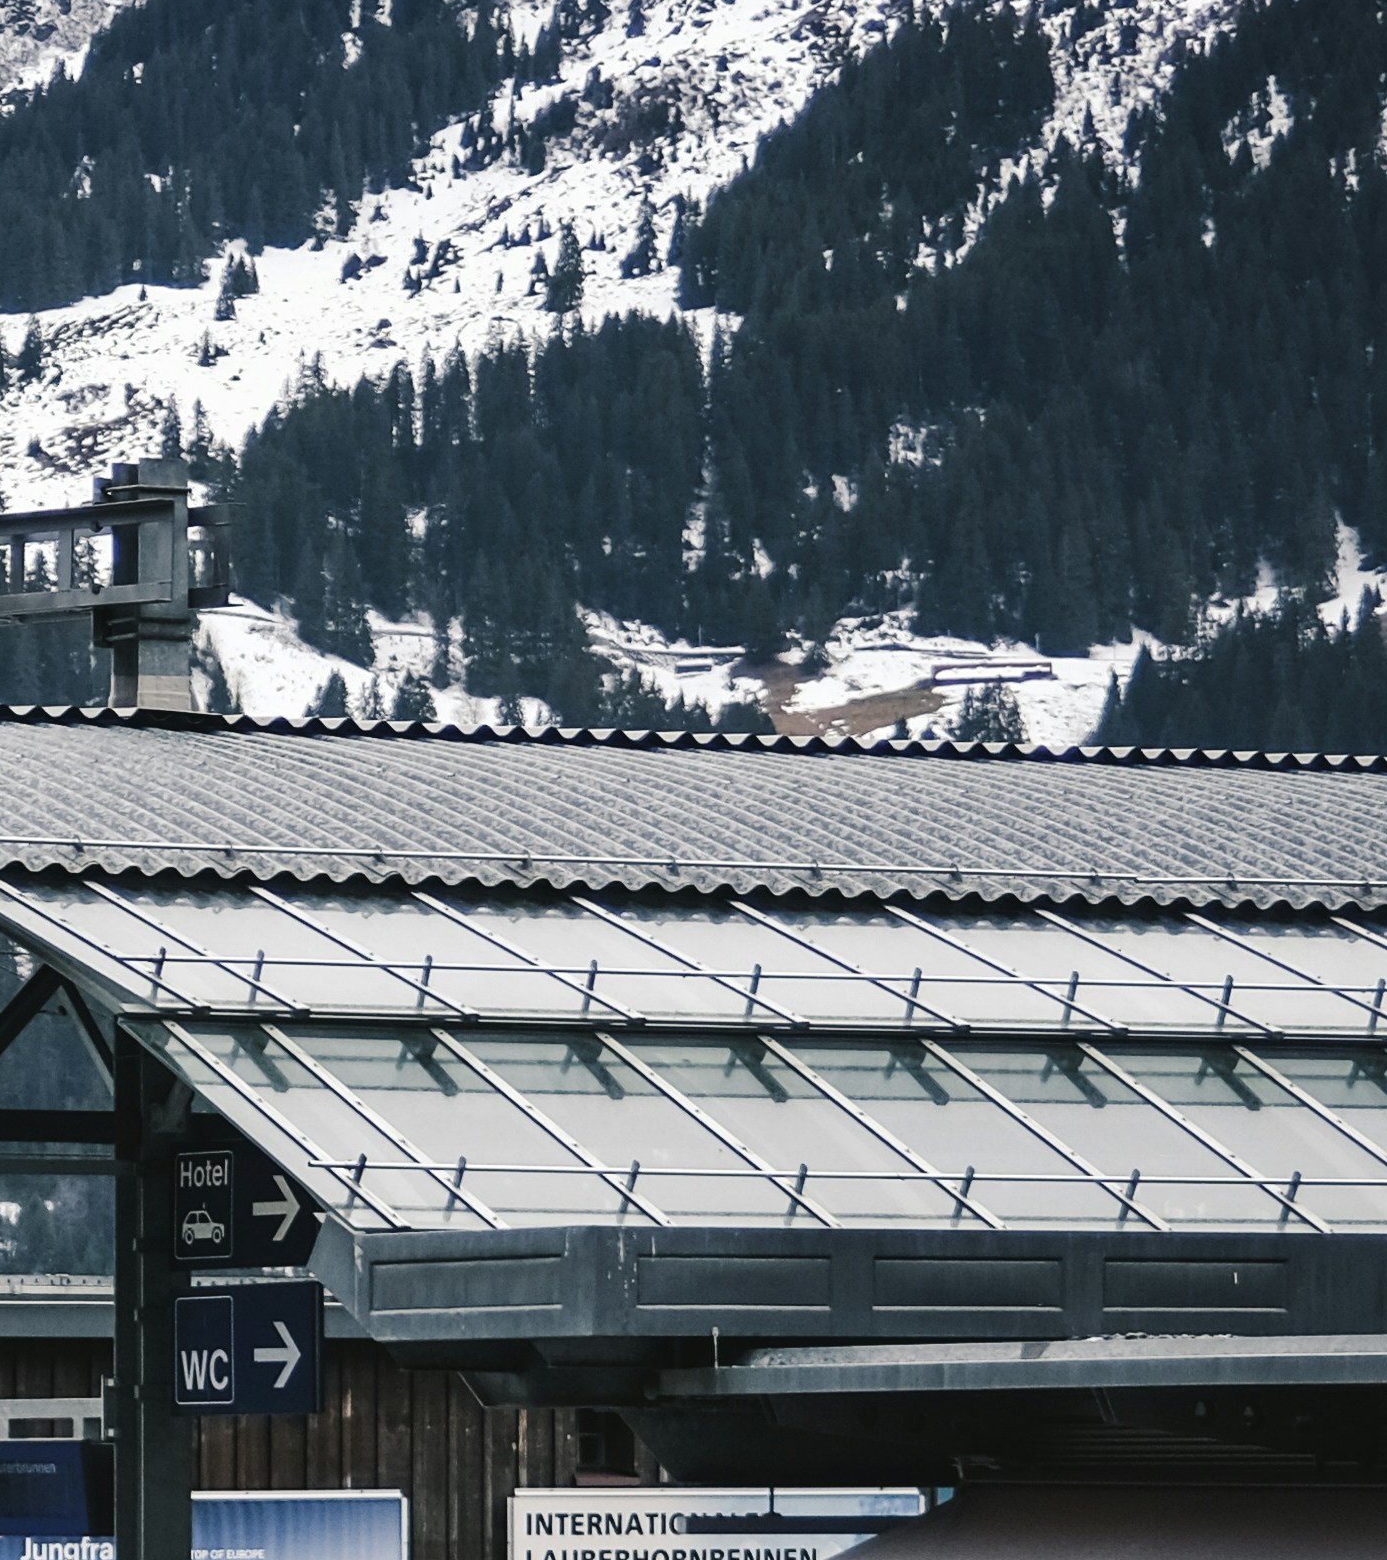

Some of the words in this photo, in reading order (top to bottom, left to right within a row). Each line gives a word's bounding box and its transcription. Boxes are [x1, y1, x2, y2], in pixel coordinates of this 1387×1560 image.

[180, 1159, 228, 1187] Hotel
[181, 1348, 229, 1391] WC
[226, 1549, 265, 1560] EUROPE
